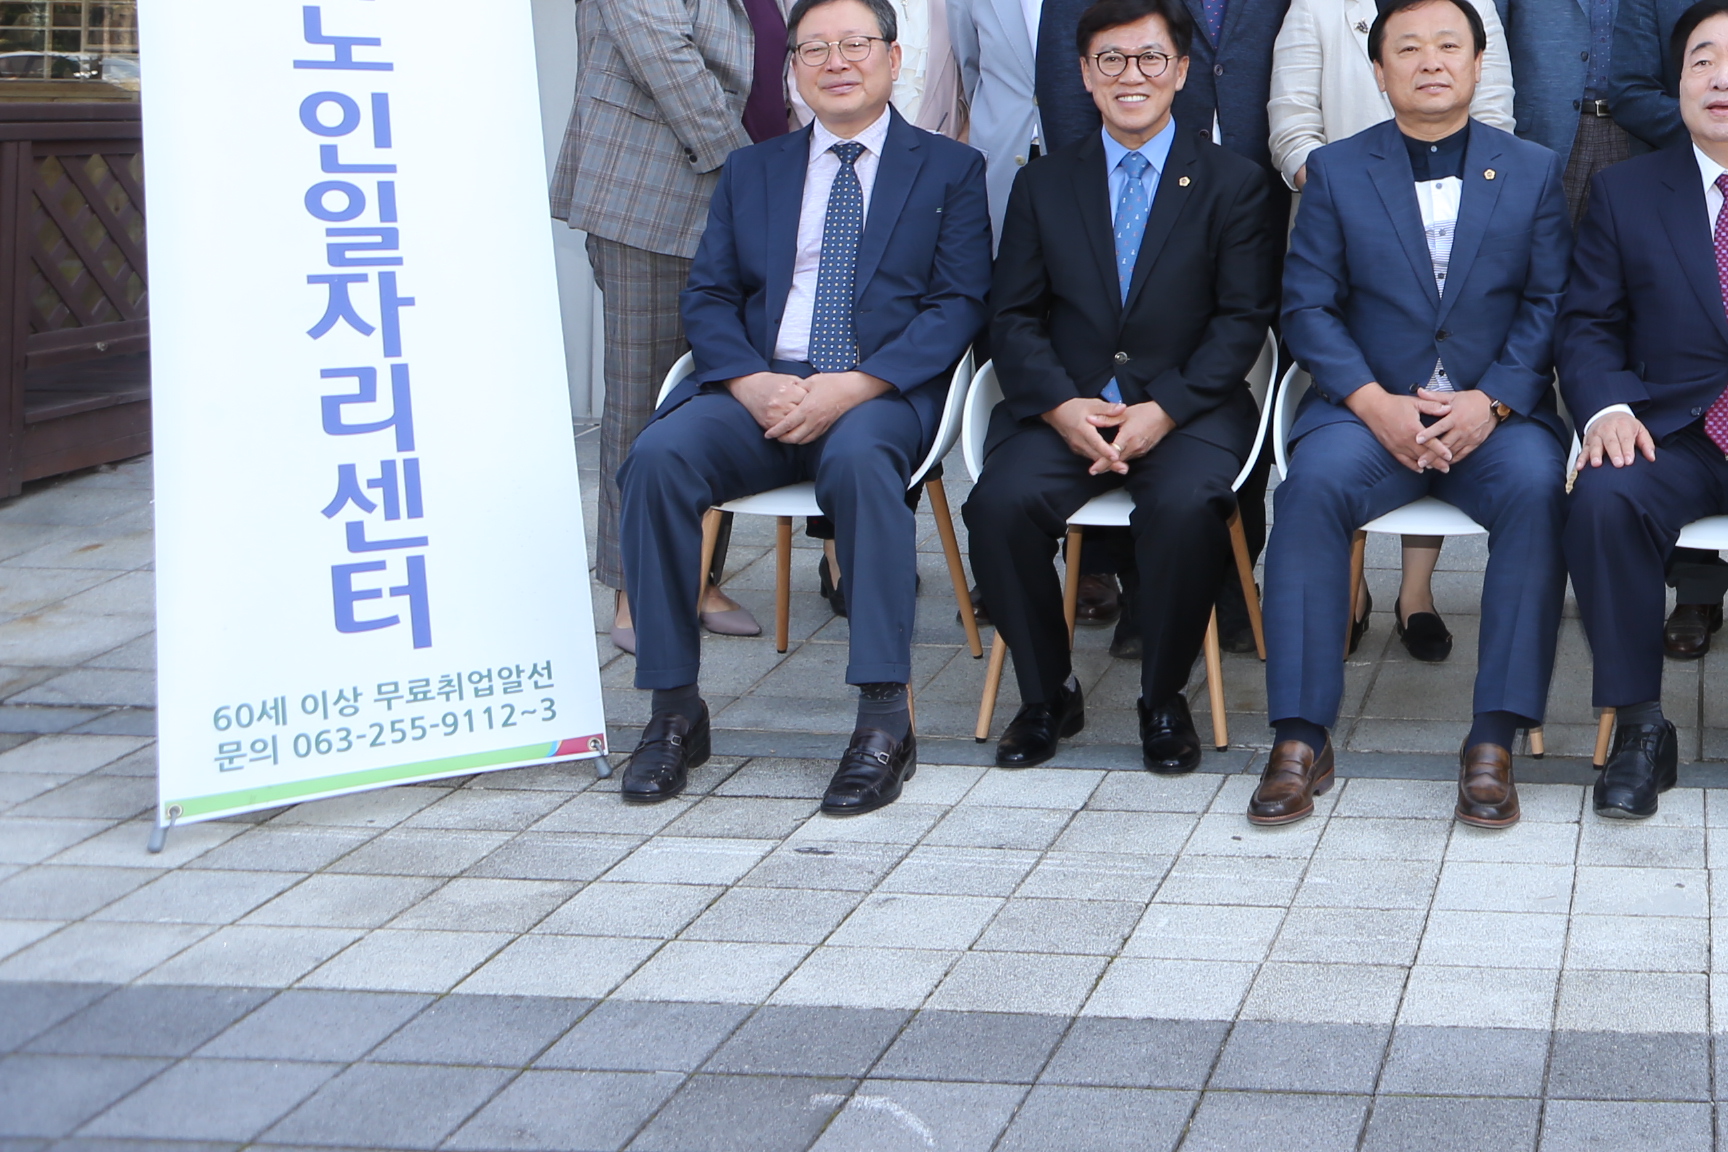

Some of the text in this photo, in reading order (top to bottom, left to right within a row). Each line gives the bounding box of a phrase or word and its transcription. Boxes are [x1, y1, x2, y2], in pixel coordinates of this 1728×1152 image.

[213, 659, 556, 732] 60세 이상 무료취업알선
[214, 698, 558, 773] 문의 063-255-9112~3
